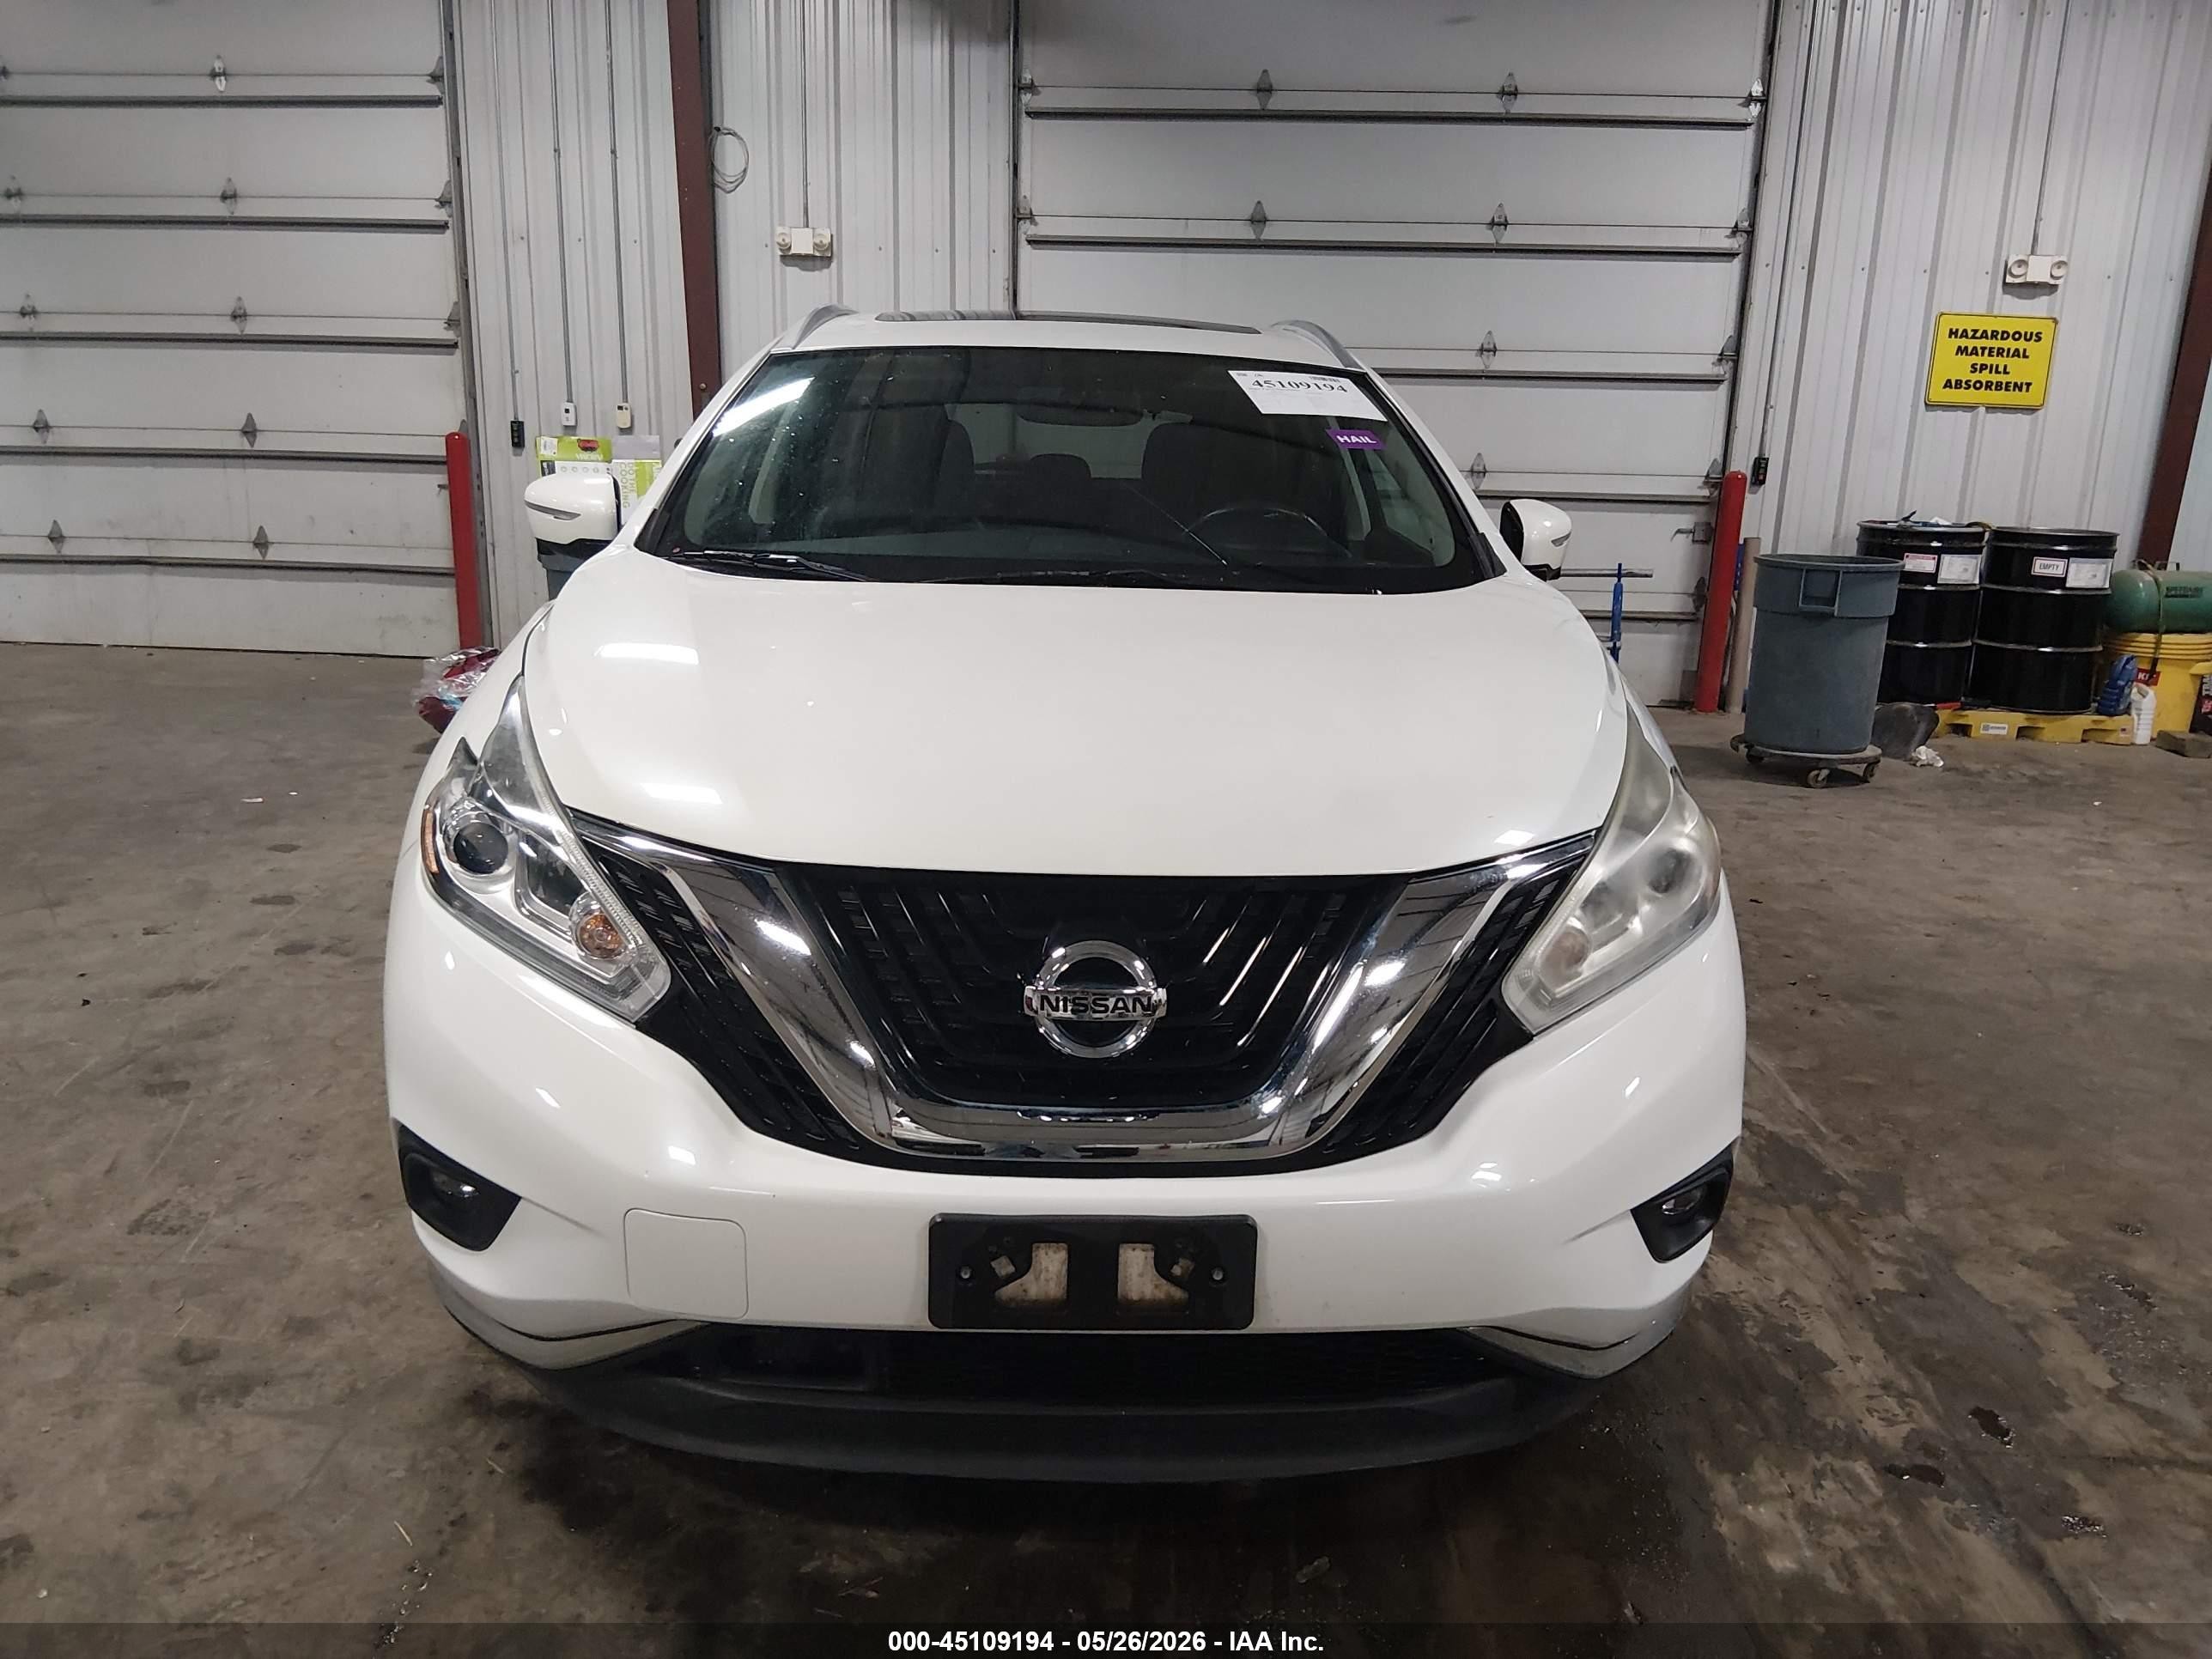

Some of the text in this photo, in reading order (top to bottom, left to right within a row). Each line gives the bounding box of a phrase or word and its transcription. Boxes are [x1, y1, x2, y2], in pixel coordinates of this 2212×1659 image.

[1948, 328, 2043, 343] HAZARDOUS
[1954, 345, 2030, 359] MATERIAL
[1969, 362, 2010, 374] SPILL
[1251, 380, 1348, 392] 45109194
[1942, 379, 2033, 392] ABSORBENT
[1336, 435, 1376, 444] HAIL
[619, 462, 630, 508] COOKING
[1039, 994, 1152, 1014] NISSAN
